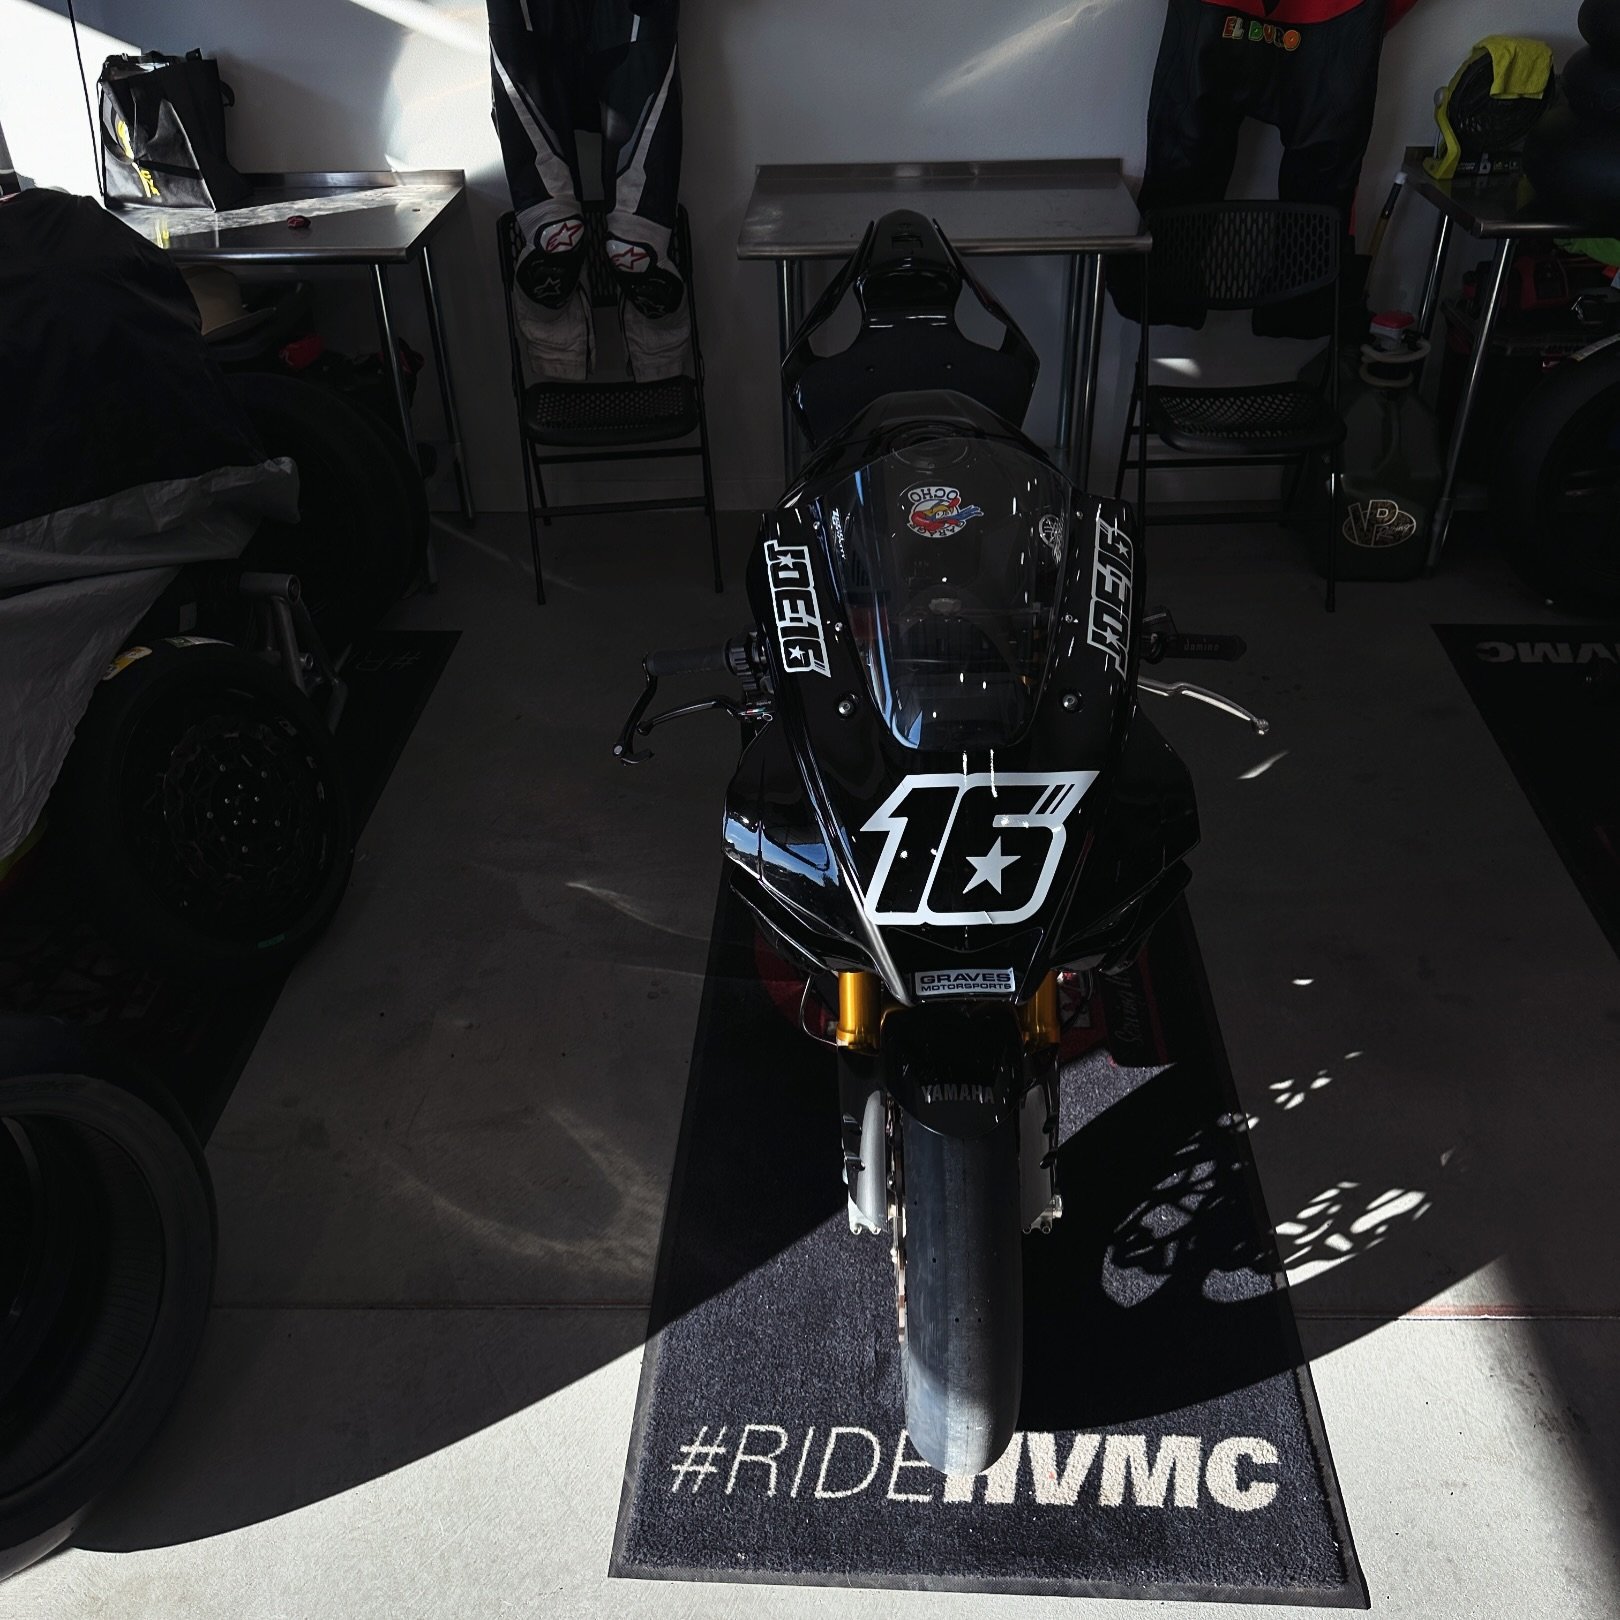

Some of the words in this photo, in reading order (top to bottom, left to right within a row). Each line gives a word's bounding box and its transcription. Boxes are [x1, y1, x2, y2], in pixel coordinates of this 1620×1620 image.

[1222, 16, 1244, 40] EL
[1248, 20, 1302, 52] DURO
[909, 487, 959, 503] OCHO
[1347, 499, 1399, 548] VP
[860, 770, 1099, 927] 16
[919, 972, 1011, 985] GRAVES
[920, 982, 1012, 992] MOTORSPORTS
[920, 1083, 995, 1104] YAMAHA
